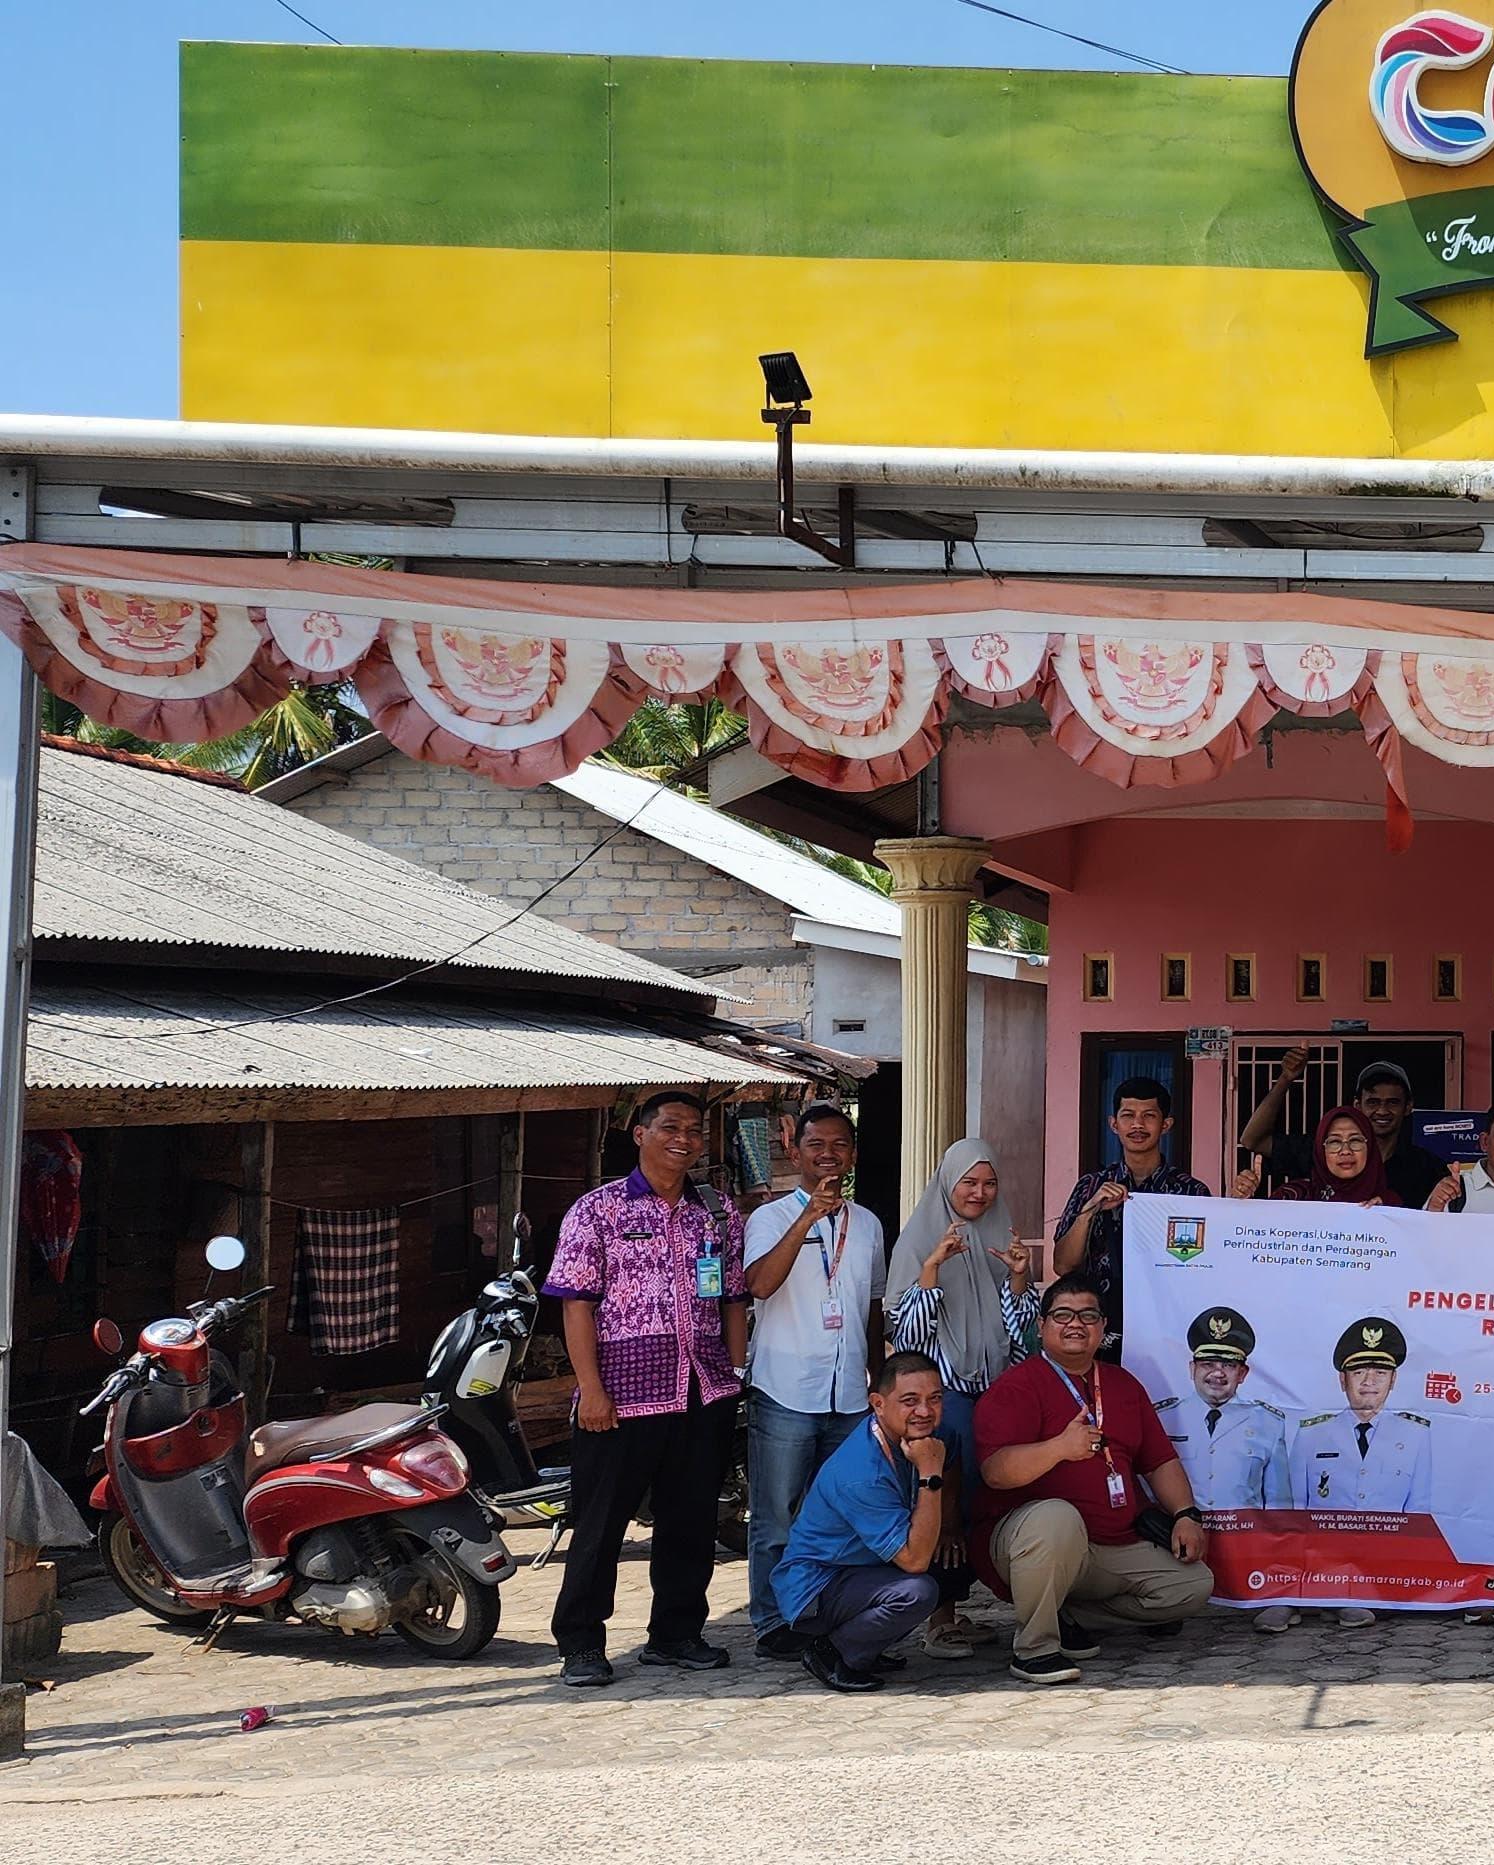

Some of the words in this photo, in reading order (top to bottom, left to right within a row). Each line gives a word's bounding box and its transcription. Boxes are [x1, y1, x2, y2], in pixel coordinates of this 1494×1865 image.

[1451, 1133, 1480, 1141] TRAD
[1235, 1226, 1267, 1237] Dinas
[1224, 1239, 1299, 1252] Perindustrian
[1301, 1241, 1323, 1253] dan
[1326, 1244, 1397, 1259] Perdagangan
[1252, 1254, 1313, 1267] Kabupaten
[1316, 1257, 1371, 1271] Semarang
[1310, 1514, 1335, 1522] WAKIL
[1336, 1514, 1364, 1523] BUPATI
[1364, 1515, 1409, 1525] SEMARANG
[1266, 1572, 1465, 1589] https://dkupp.semarangkab.go.id
